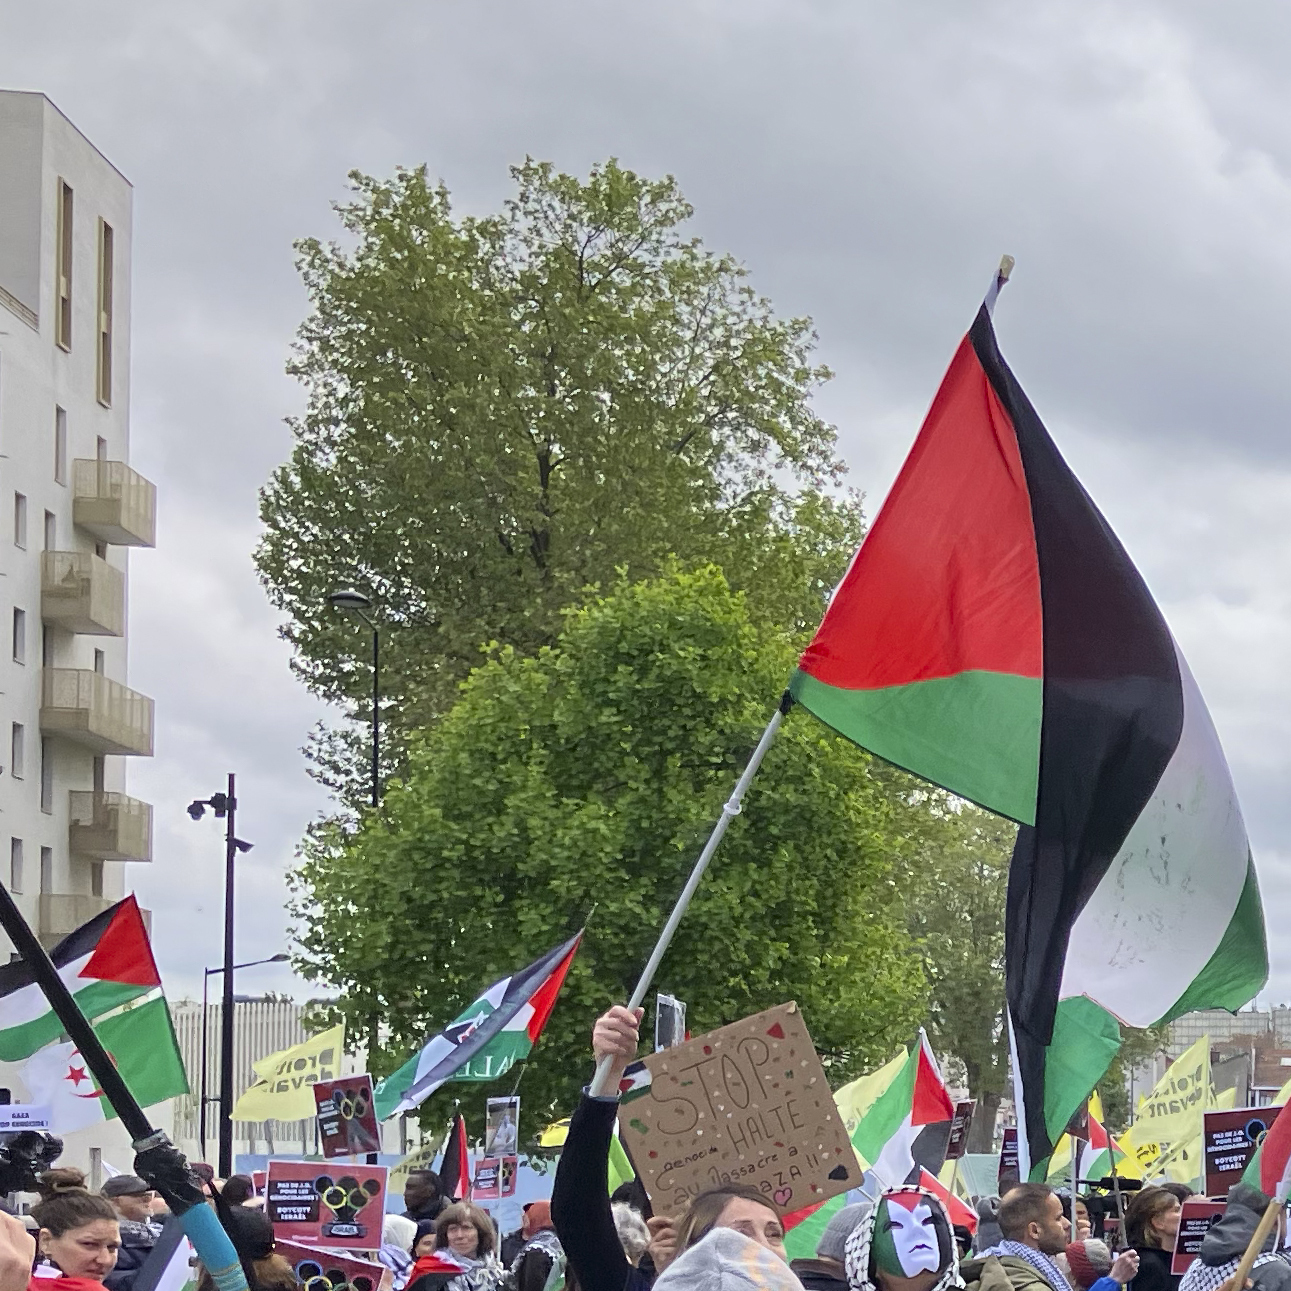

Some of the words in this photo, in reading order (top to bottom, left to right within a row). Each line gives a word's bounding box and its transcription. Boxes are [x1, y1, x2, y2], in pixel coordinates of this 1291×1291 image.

[650, 1036, 770, 1136] STOP
[725, 1099, 805, 1155] HALTE
[751, 1164, 802, 1194] aZA
